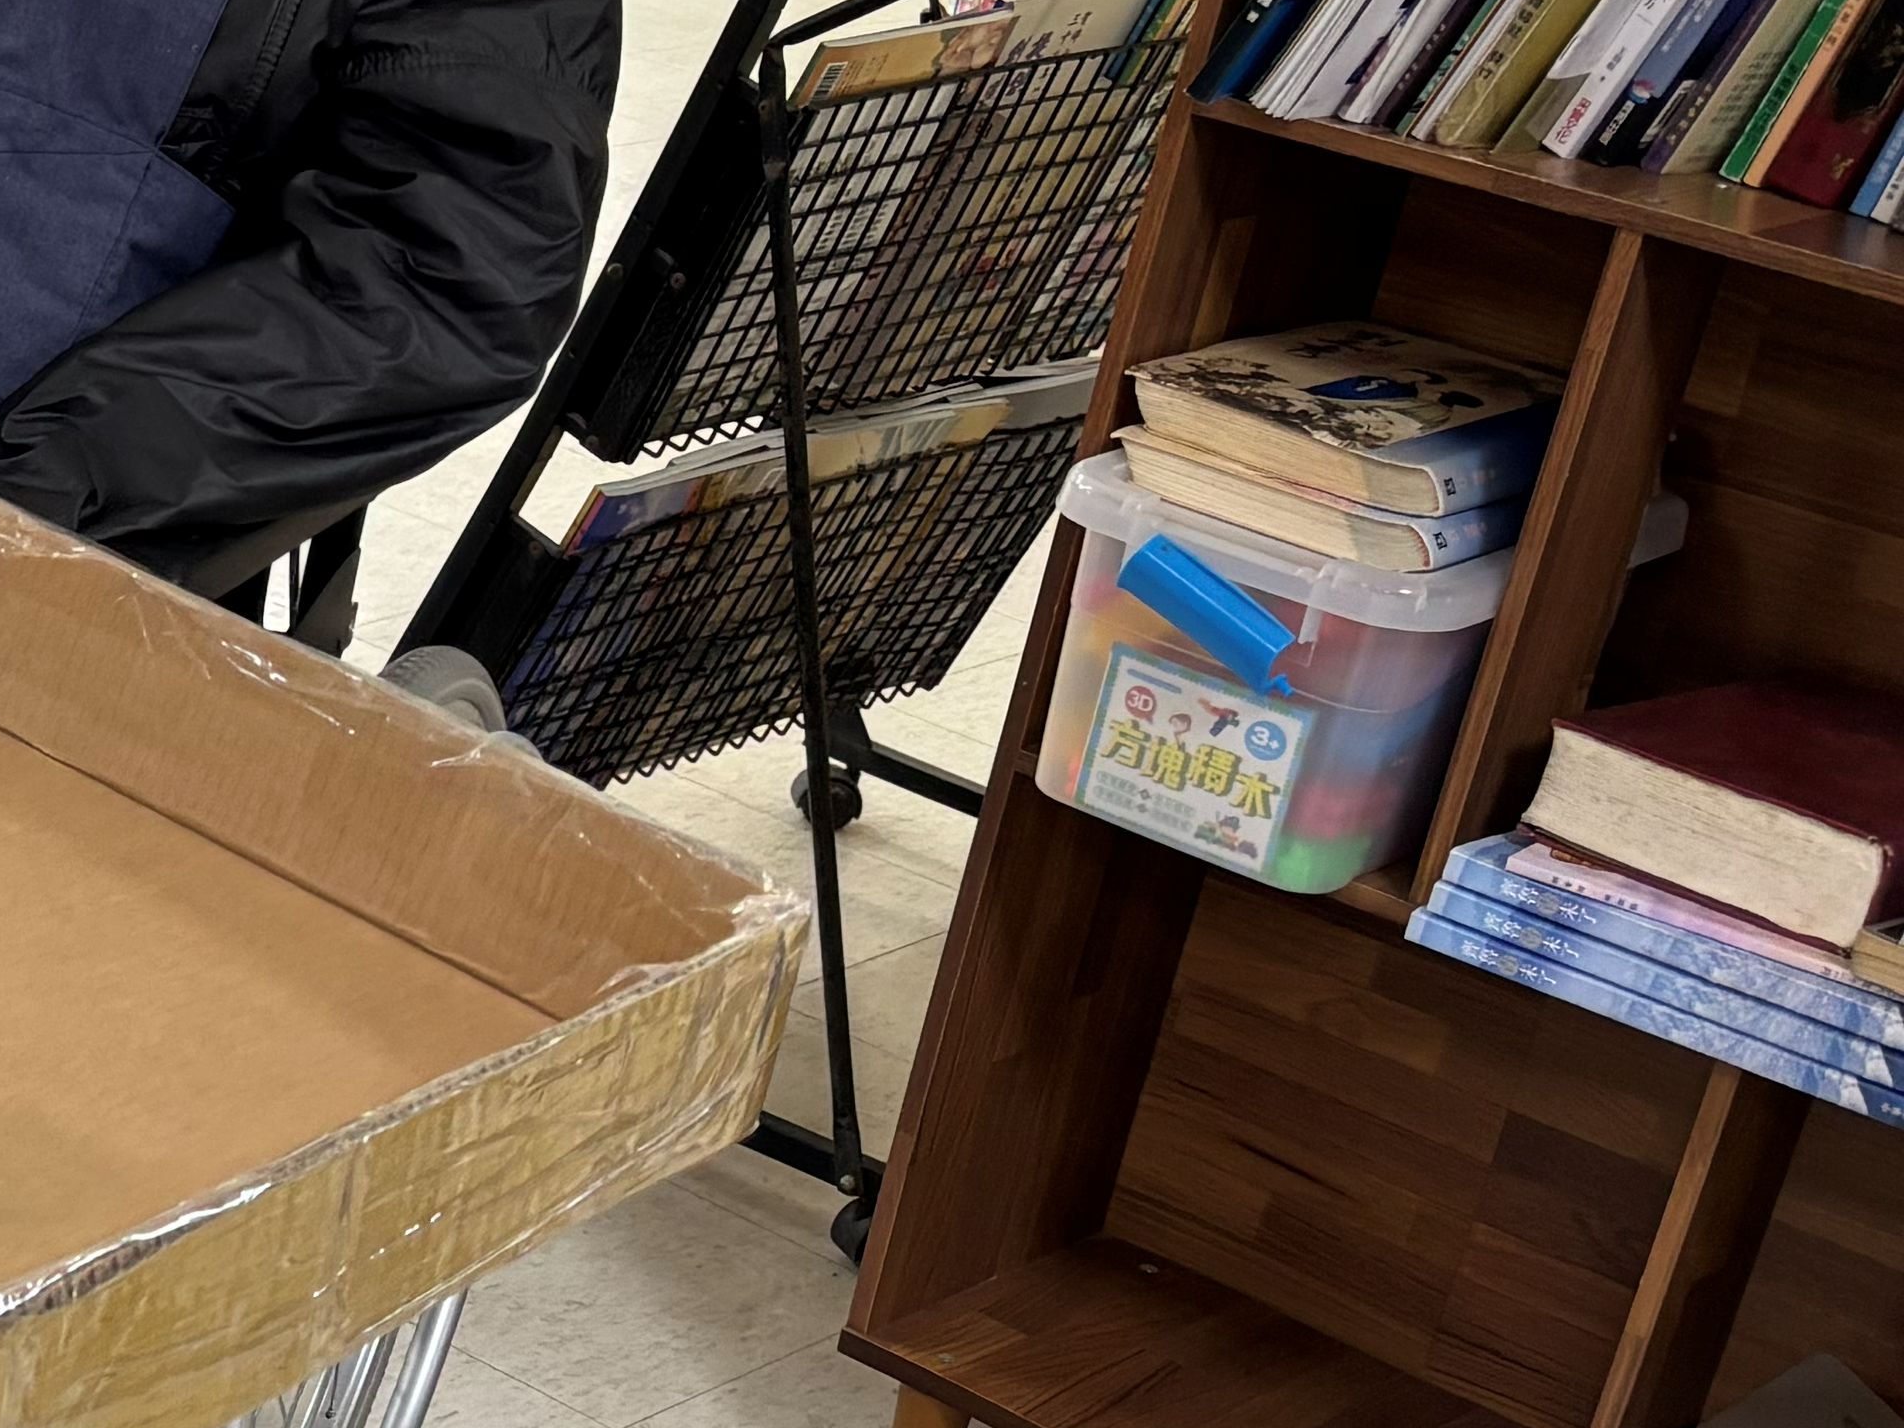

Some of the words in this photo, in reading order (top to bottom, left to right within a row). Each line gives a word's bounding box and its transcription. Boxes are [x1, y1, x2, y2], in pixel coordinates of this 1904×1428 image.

[1126, 690, 1155, 712] 3D
[1250, 725, 1281, 750] 3+
[1100, 719, 1282, 819] 方塊積木
